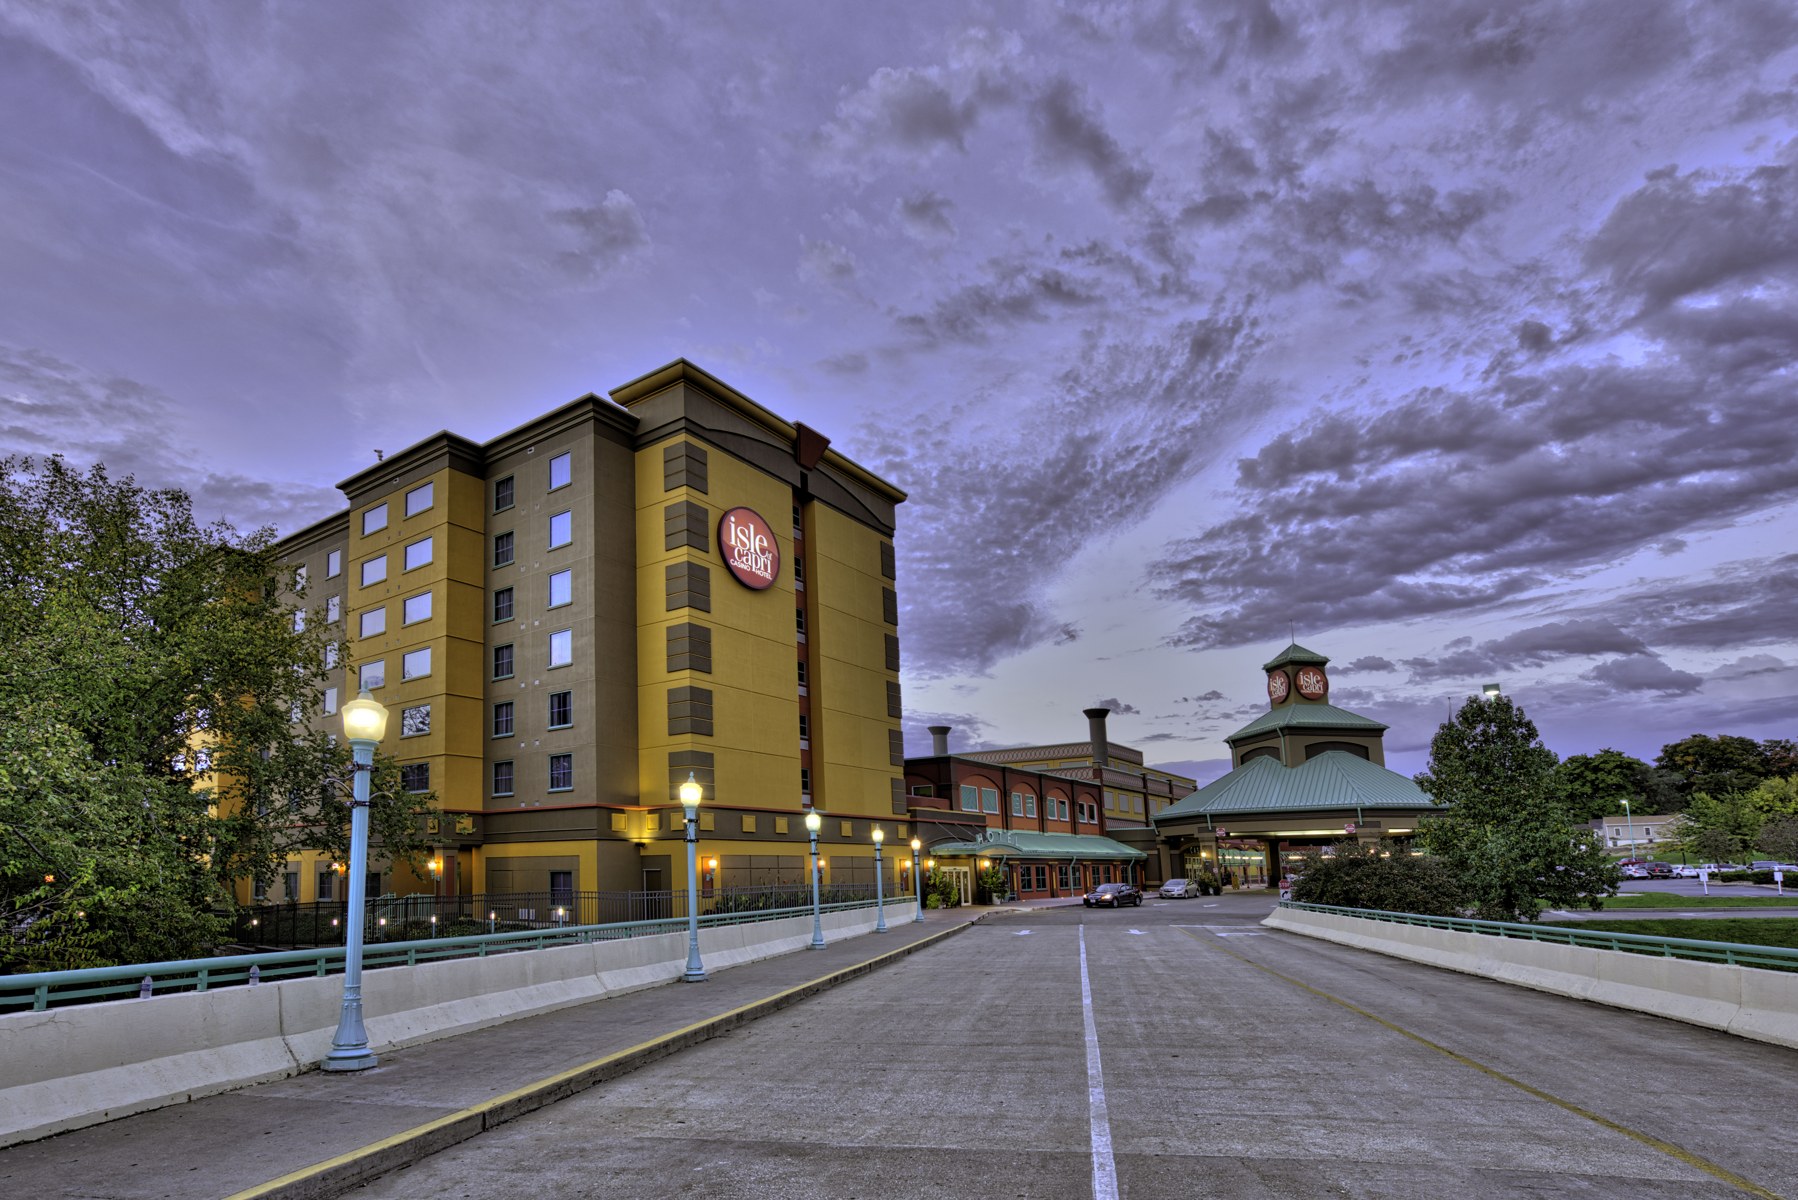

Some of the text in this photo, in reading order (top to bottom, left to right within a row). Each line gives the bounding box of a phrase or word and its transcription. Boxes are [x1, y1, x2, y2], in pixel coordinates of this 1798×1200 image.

[729, 516, 768, 557] isle
[735, 547, 771, 573] capri
[730, 559, 772, 580] CASINO HOTEL
[1300, 672, 1320, 685] isle
[1303, 683, 1323, 692] capri
[976, 831, 1019, 846] HOTEL
